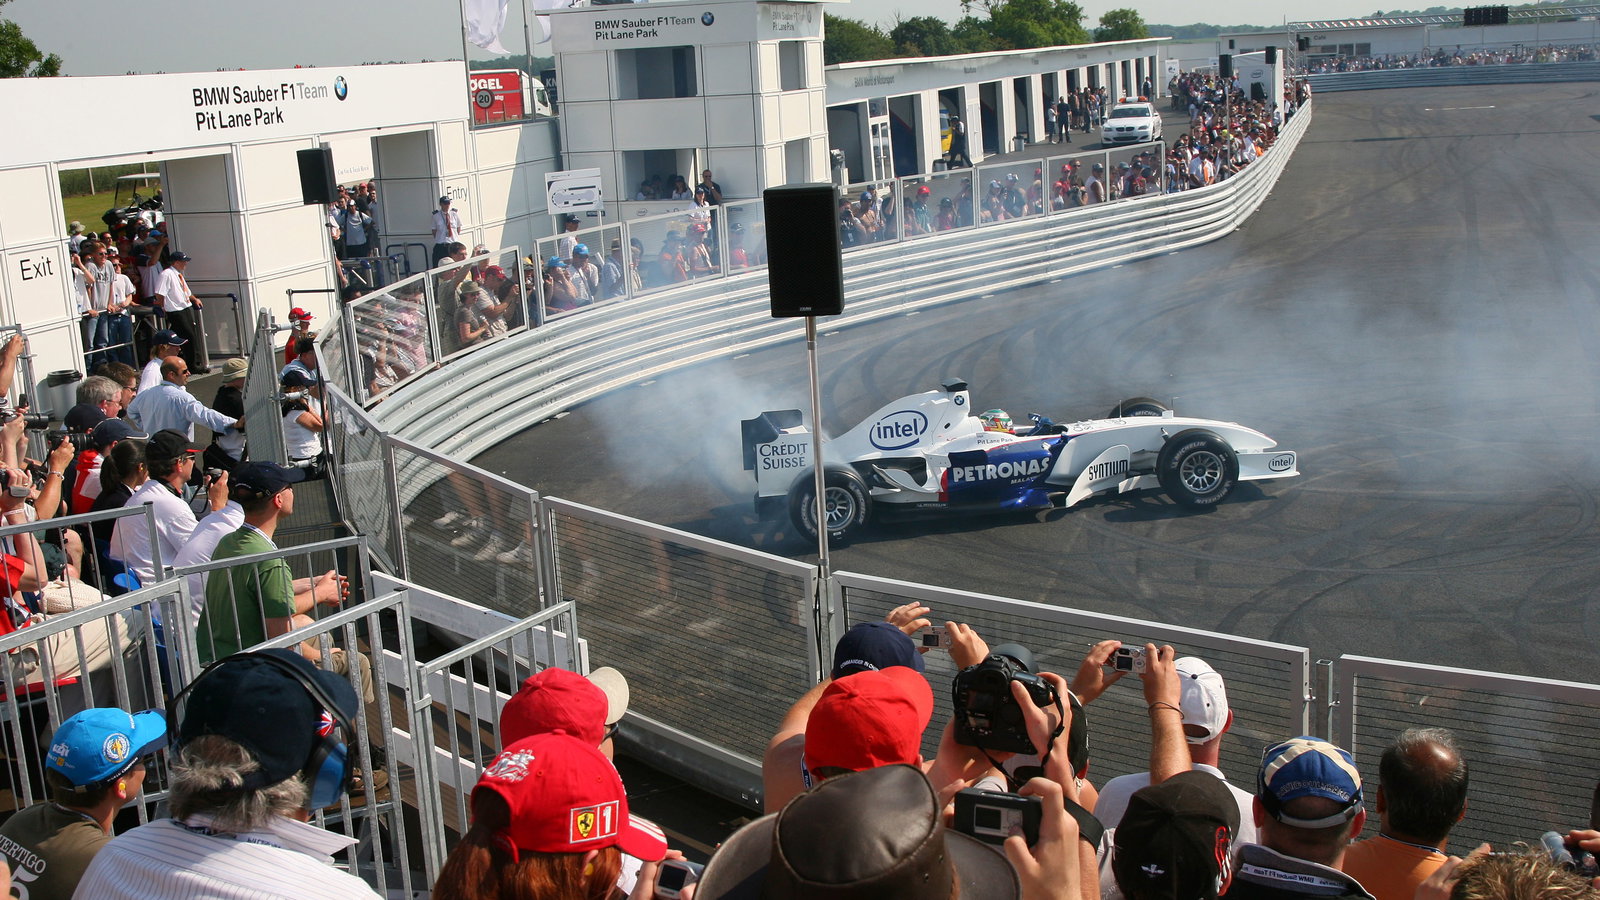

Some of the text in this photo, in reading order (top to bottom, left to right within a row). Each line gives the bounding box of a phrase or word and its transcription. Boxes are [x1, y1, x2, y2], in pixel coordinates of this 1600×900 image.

[595, 16, 696, 30] BMW Sauber F1 Team
[595, 28, 658, 40] Pit Lane Park
[192, 82, 329, 107] BMW Sauber F1 Team
[478, 94, 490, 103] 20
[195, 106, 285, 131] Pit Lane Park
[446, 186, 468, 202] Entry
[20, 256, 54, 281] Exit
[876, 418, 918, 439] intel
[759, 441, 808, 457] CRÉDIT
[763, 456, 806, 470] SUISSE
[952, 457, 1050, 483] PETRONAS
[1088, 459, 1128, 481] SYNTIUM
[1272, 457, 1291, 467] intel
[602, 805, 612, 834] 1
